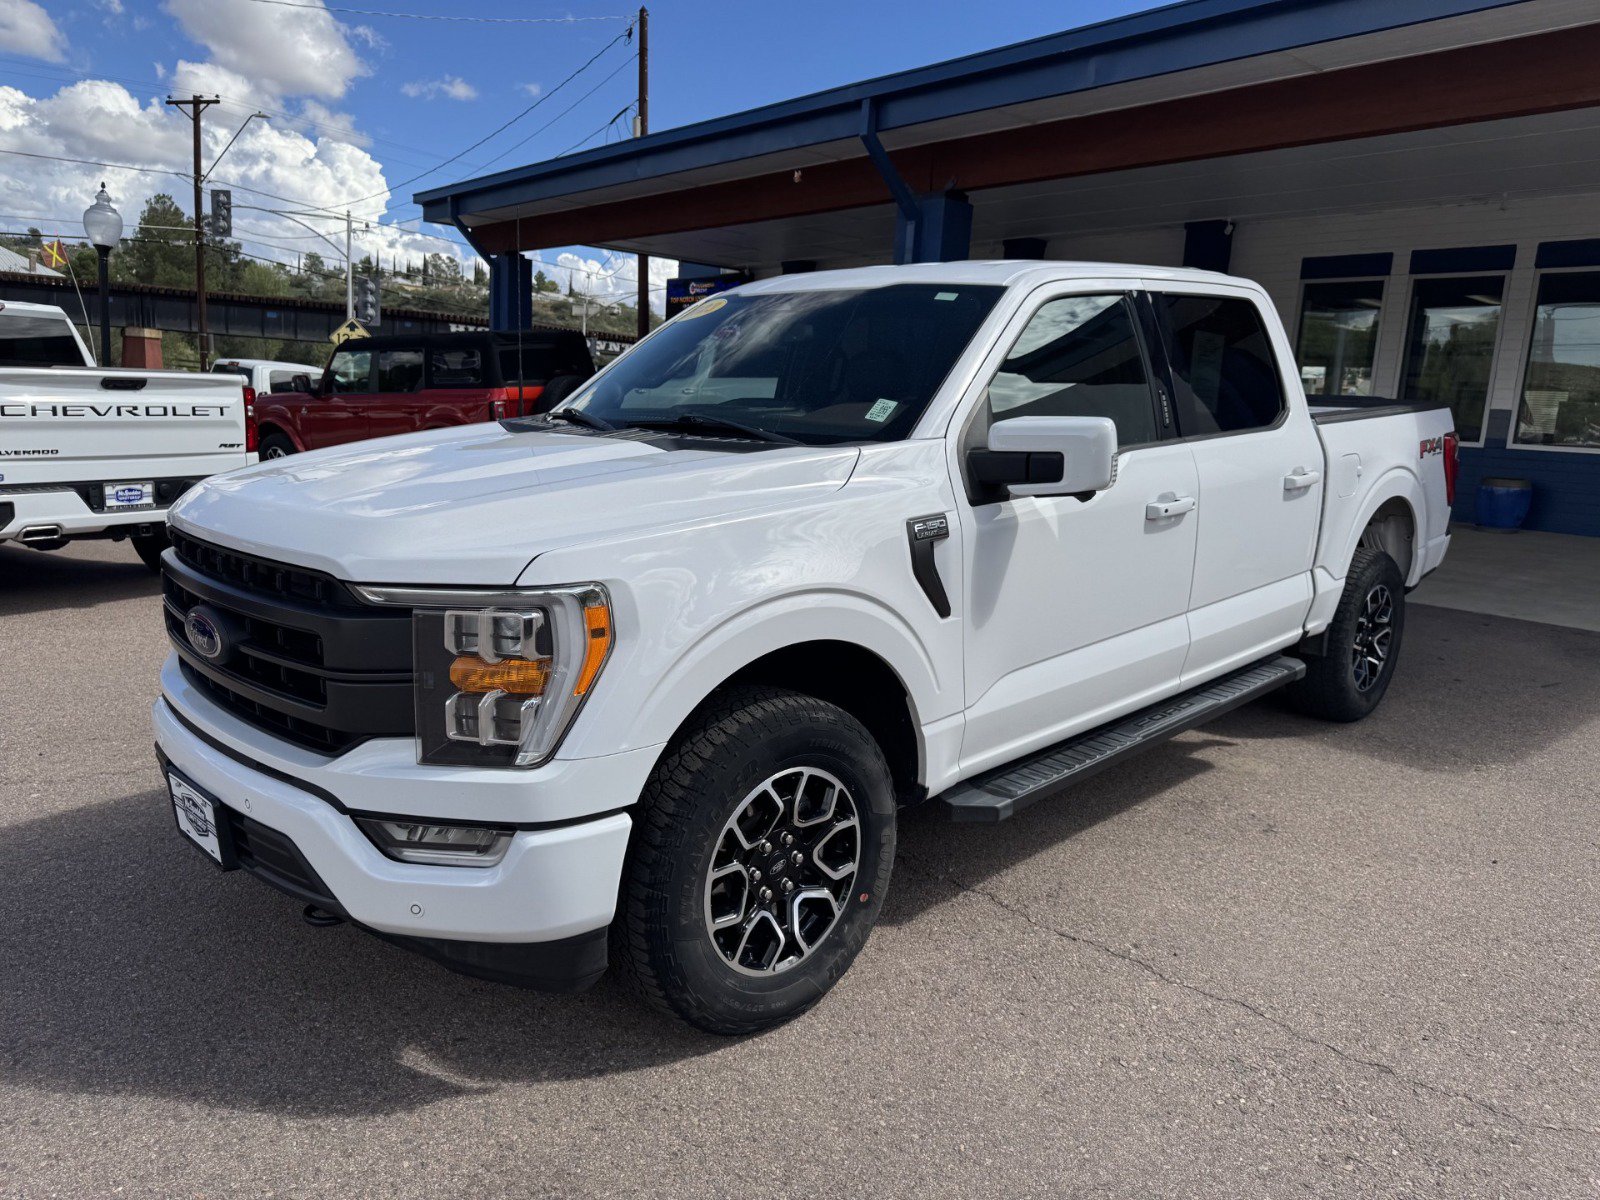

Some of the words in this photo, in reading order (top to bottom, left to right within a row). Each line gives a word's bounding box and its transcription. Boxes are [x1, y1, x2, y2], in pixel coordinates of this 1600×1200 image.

[1, 405, 230, 417] CHEVROLET
[1420, 437, 1442, 459] FX4
[915, 519, 946, 533] F-150
